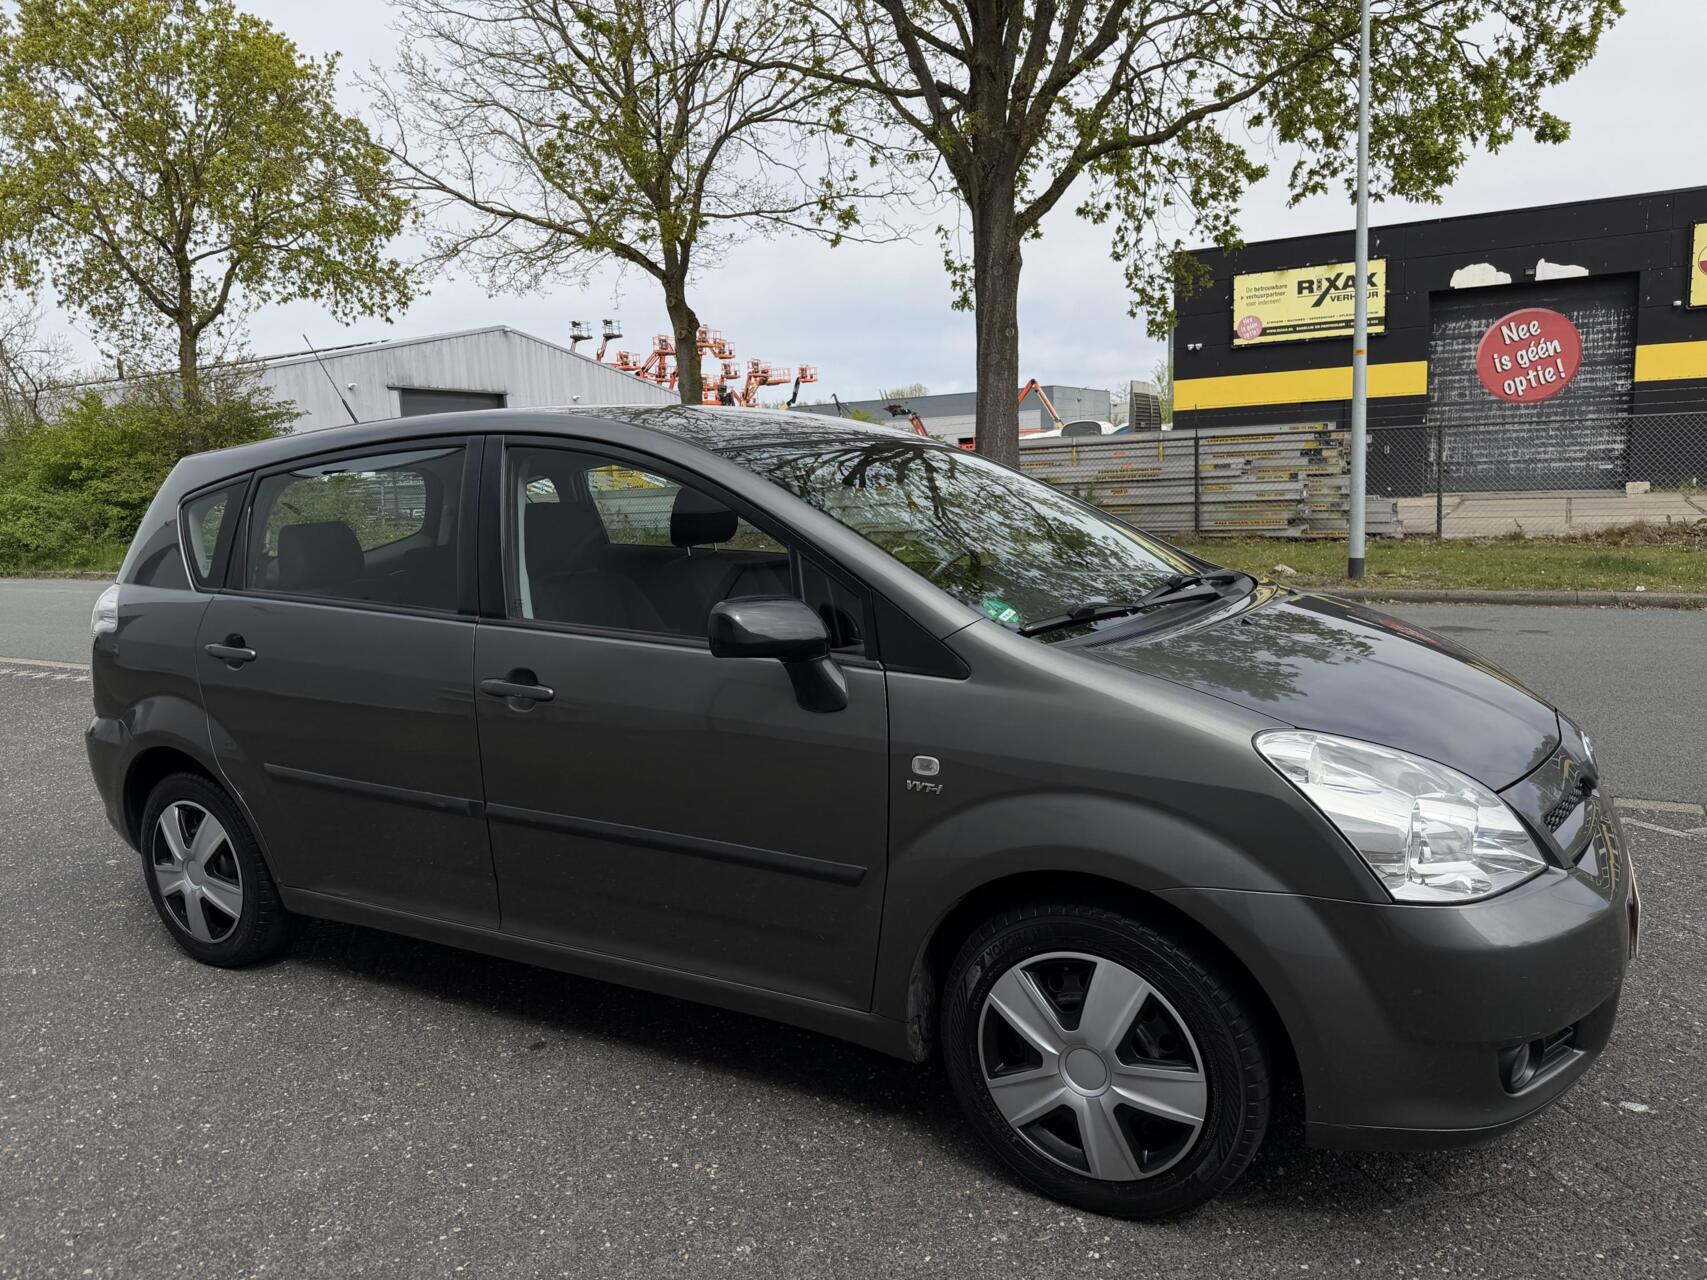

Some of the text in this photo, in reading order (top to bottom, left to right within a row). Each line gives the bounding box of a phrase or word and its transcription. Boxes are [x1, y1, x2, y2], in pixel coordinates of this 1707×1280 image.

[1254, 284, 1288, 292] betrouwbare
[1246, 291, 1286, 299] verhuurpartner
[1330, 291, 1379, 302] VERHUR
[1501, 320, 1541, 345] Nee
[1493, 338, 1562, 373] is géén
